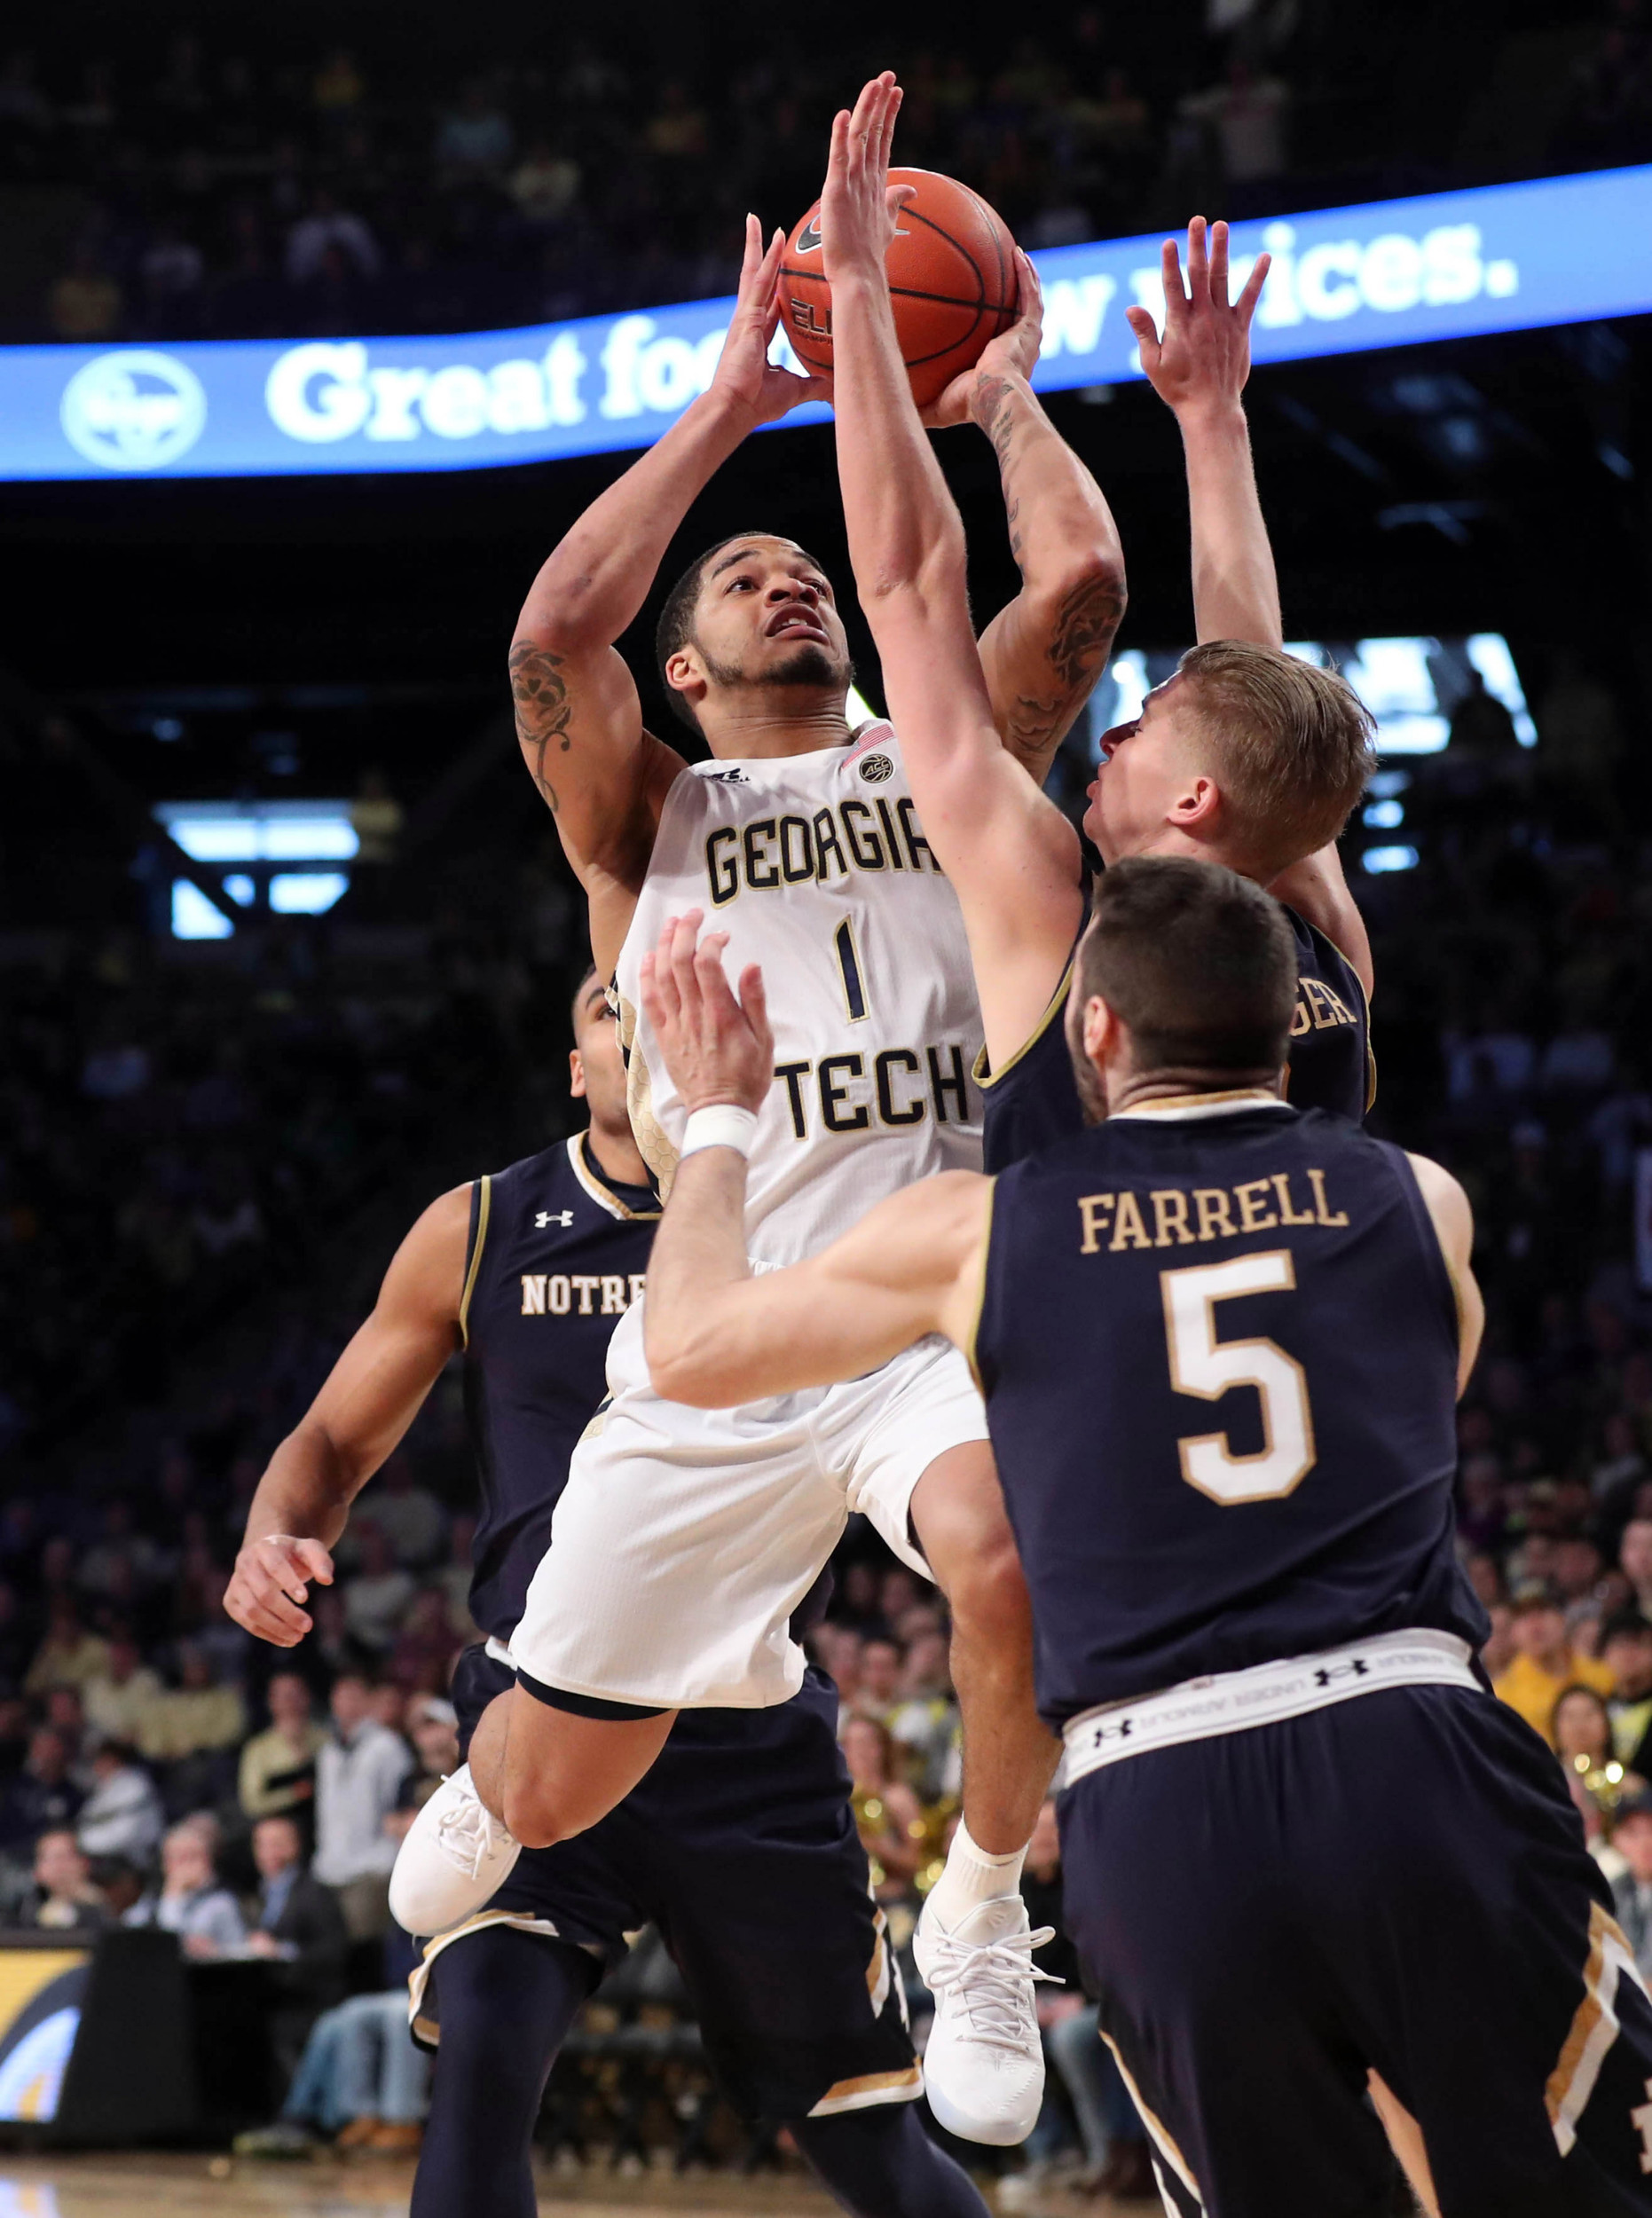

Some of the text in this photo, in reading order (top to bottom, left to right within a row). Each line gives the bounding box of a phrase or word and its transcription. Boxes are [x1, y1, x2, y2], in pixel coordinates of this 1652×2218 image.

[265, 331, 586, 443] Great
[865, 759, 890, 775] ACC
[705, 797, 945, 909] GEORGIA
[833, 914, 870, 1024] 1
[773, 1043, 970, 1141] TECH
[1078, 1168, 1349, 1255] FARRELL
[1160, 1248, 1317, 1506] 5
